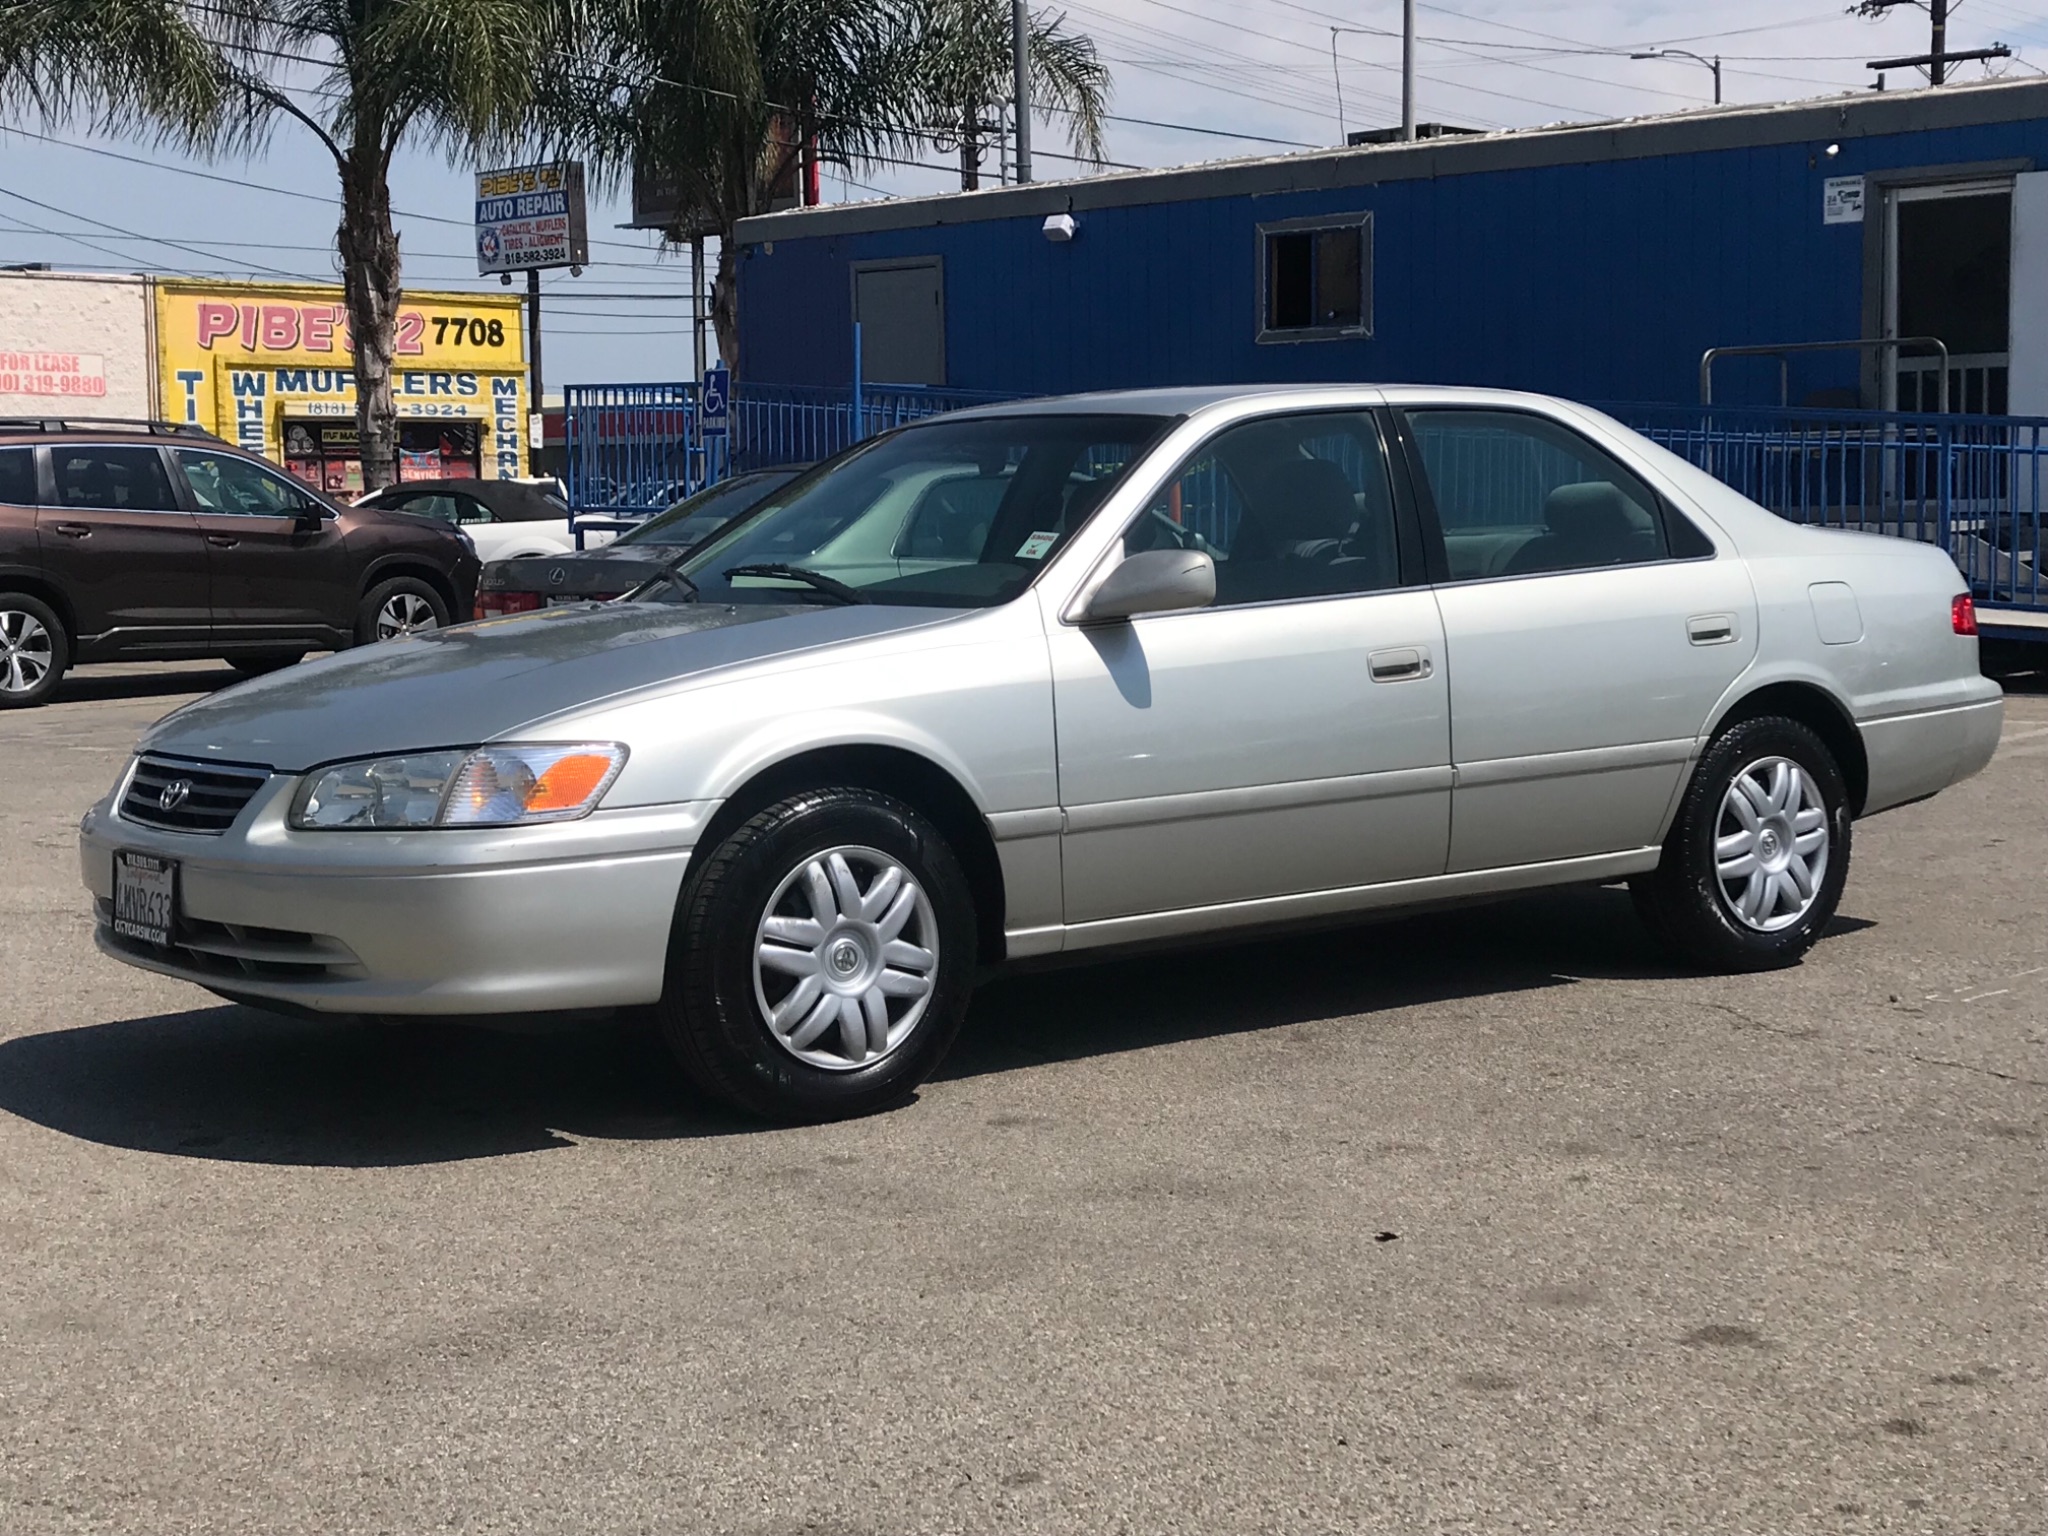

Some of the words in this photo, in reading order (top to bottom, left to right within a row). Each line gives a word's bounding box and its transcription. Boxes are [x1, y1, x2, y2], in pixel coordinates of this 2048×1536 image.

[480, 172, 537, 198] PIBE'S
[480, 200, 514, 221] AUTO
[517, 192, 565, 216] REPAIR
[535, 217, 567, 233] MUFFLERS
[504, 238, 524, 250] TIRES
[505, 248, 566, 265] 818-582-3924
[432, 316, 505, 347] 7708
[0, 353, 31, 371] FOR
[34, 354, 80, 373] LEASE
[24, 374, 103, 393] 319-9880
[308, 402, 346, 415] (818)
[703, 416, 726, 429] PARKING
[400, 468, 442, 480] SERVICE
[1031, 534, 1055, 542] SMOG
[1026, 548, 1038, 556] OK
